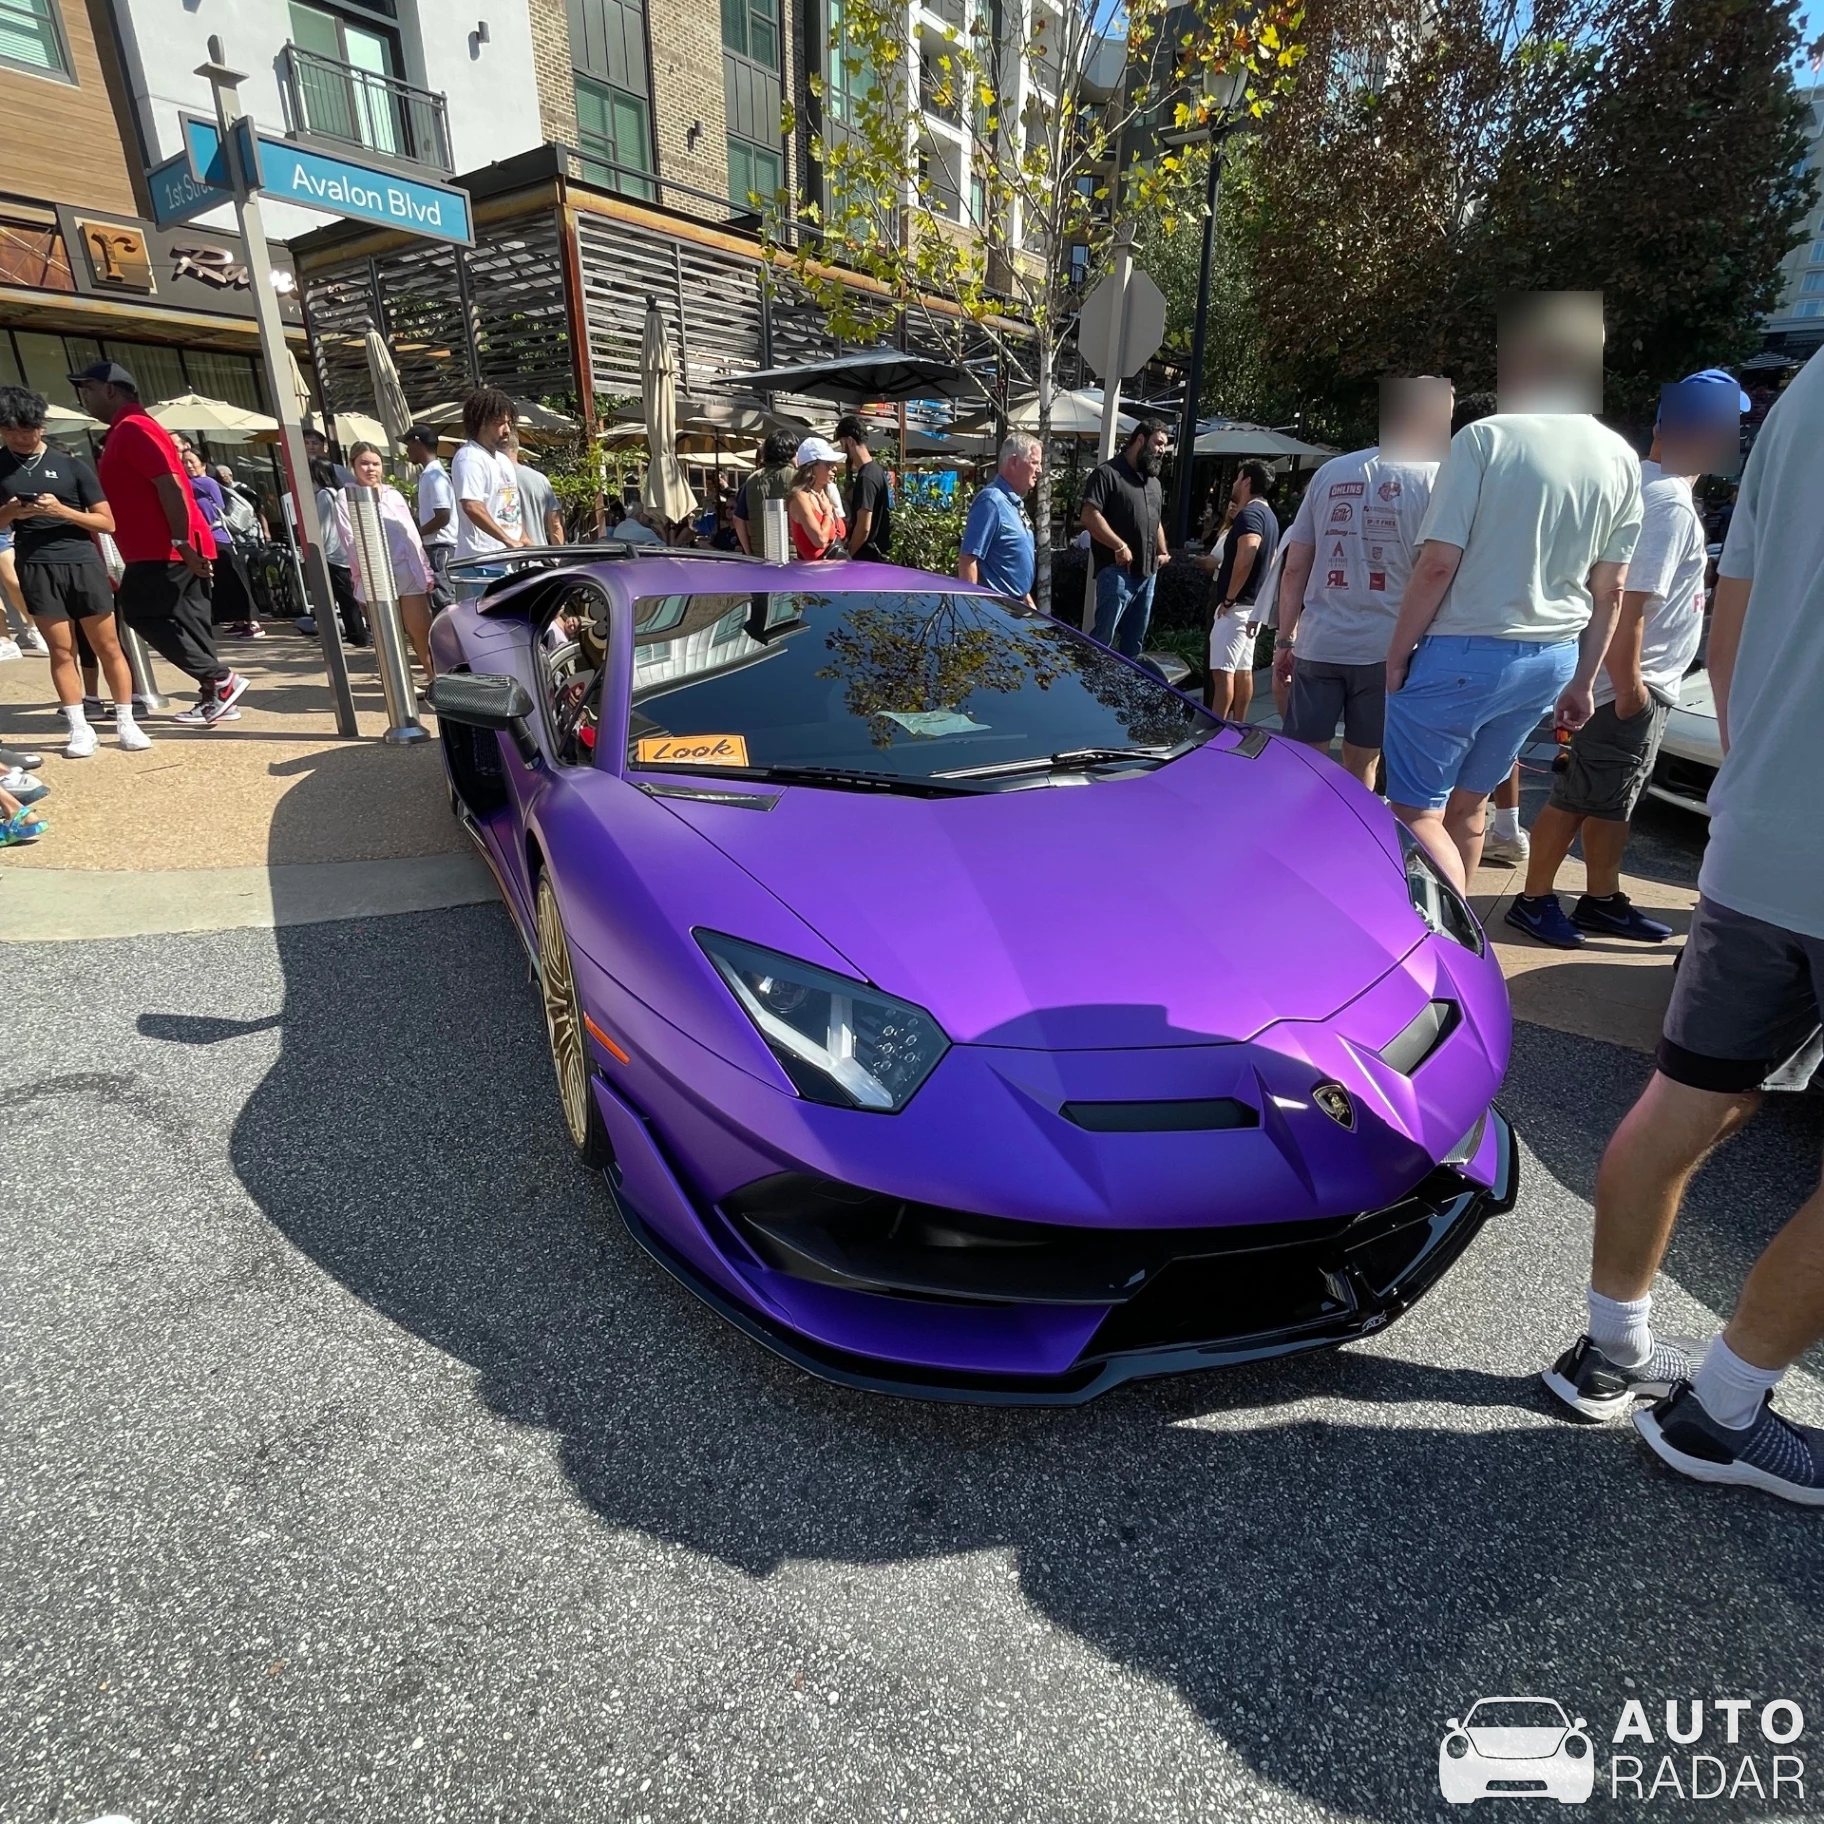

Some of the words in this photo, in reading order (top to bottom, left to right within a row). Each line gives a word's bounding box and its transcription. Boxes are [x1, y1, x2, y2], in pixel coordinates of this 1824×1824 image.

[165, 180, 186, 210] 1st
[183, 173, 215, 202] Stre
[292, 163, 383, 212] Avalon
[387, 187, 442, 227] Blvd
[653, 738, 735, 760] Look
